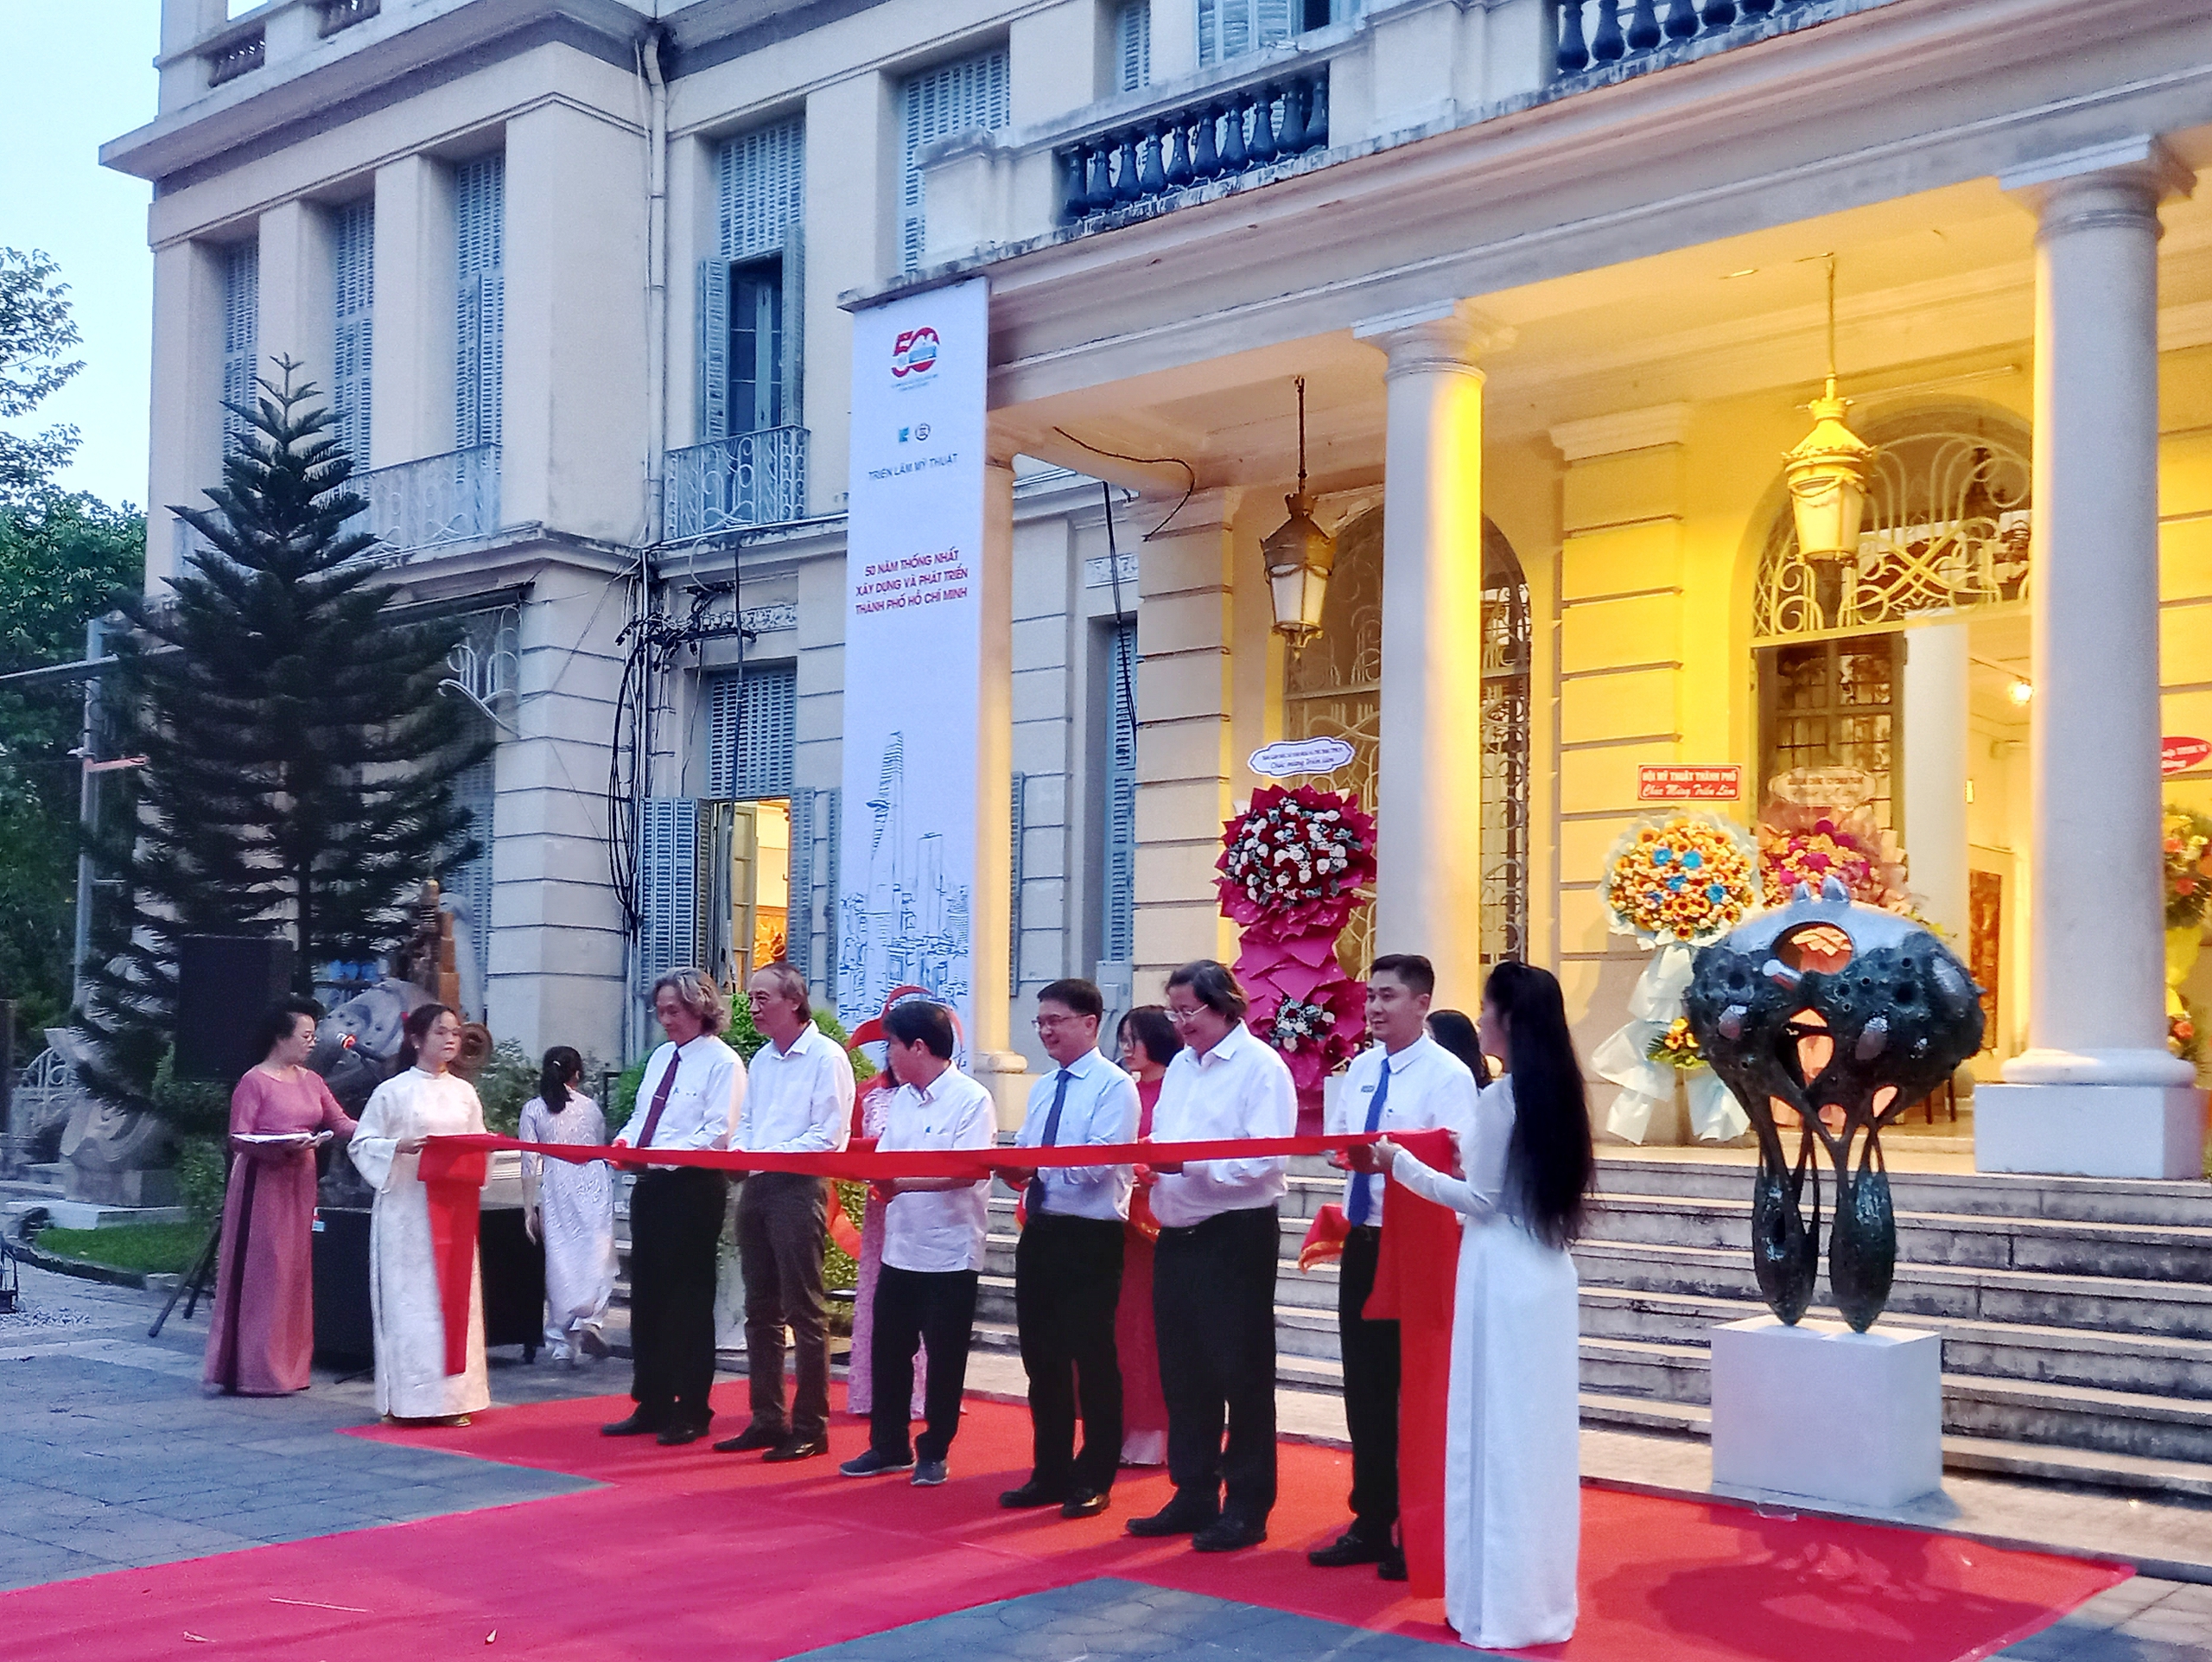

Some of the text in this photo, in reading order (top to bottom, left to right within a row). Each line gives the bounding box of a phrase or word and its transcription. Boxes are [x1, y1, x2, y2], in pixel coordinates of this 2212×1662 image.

[865, 564, 876, 576] 50
[900, 552, 932, 570] THỐNG
[934, 546, 959, 564] NHẤT
[855, 563, 969, 596] XÂY DỰNG VÀ PHÁT TRIỂN
[855, 587, 968, 614] THÀNH PHỐ HỒ CHÍ MINH
